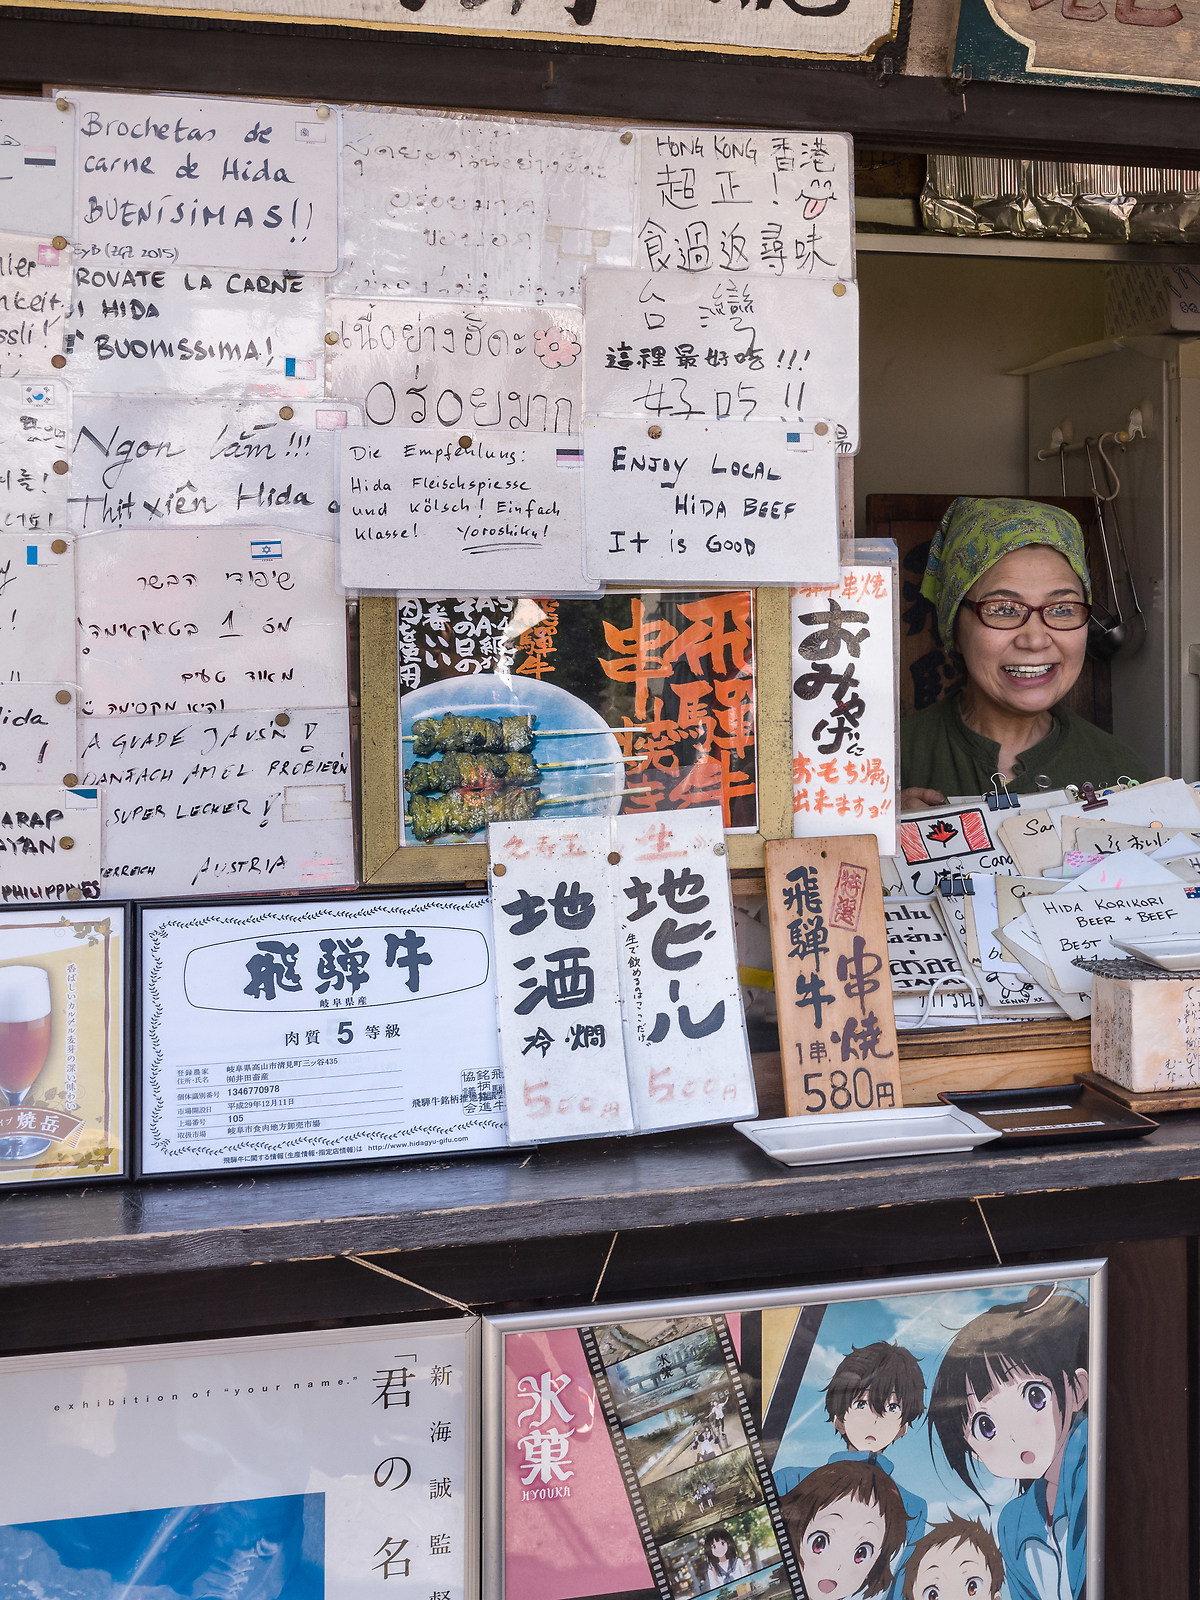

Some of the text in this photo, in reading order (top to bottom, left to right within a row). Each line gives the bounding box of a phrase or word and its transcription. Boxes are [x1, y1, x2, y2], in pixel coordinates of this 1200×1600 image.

[243, 125, 273, 144] de
[657, 135, 835, 173] HONG KONG 香港
[84, 153, 295, 184] carne de Hida
[184, 273, 212, 291] LA
[226, 273, 304, 294] CARNE
[102, 299, 160, 319] HIDA
[74, 425, 186, 489] Ngon
[349, 445, 381, 459] Die
[711, 453, 782, 481] LOCAL
[237, 481, 314, 510] Hida
[351, 477, 392, 492] Hida
[352, 502, 387, 516] und
[497, 499, 560, 517] Einfach
[743, 498, 797, 519] BEEF
[671, 530, 687, 553] is
[705, 535, 756, 556] GOOD
[106, 805, 165, 826] SUPER
[192, 856, 287, 885] AUSTRIA
[1044, 896, 1164, 915] HIDA KORIKORI
[1076, 908, 1178, 928] BEER BEEF
[501, 881, 596, 1016] 地酒
[622, 867, 725, 1044] 地ビール
[783, 865, 836, 1030] 飛騨牛
[1060, 938, 1102, 952] BEST
[243, 929, 433, 1001] 飛騨牛
[319, 995, 368, 1009] 岐阜県産
[831, 935, 894, 1063] 串焼
[999, 997, 1030, 1005] KENNY
[336, 1021, 355, 1045] 5
[227, 1084, 280, 1096] 1346770978
[803, 1068, 895, 1114] 580円
[16, 1111, 61, 1134] 焼岳
[228, 1114, 244, 1123] 105
[368, 1135, 469, 1151] http://www.hidagyu-gifu.com
[54, 1391, 179, 1411] exhibition
[192, 1387, 212, 1398] of
[516, 1371, 575, 1486] 氷菓
[521, 1487, 572, 1501] HYOUKA
